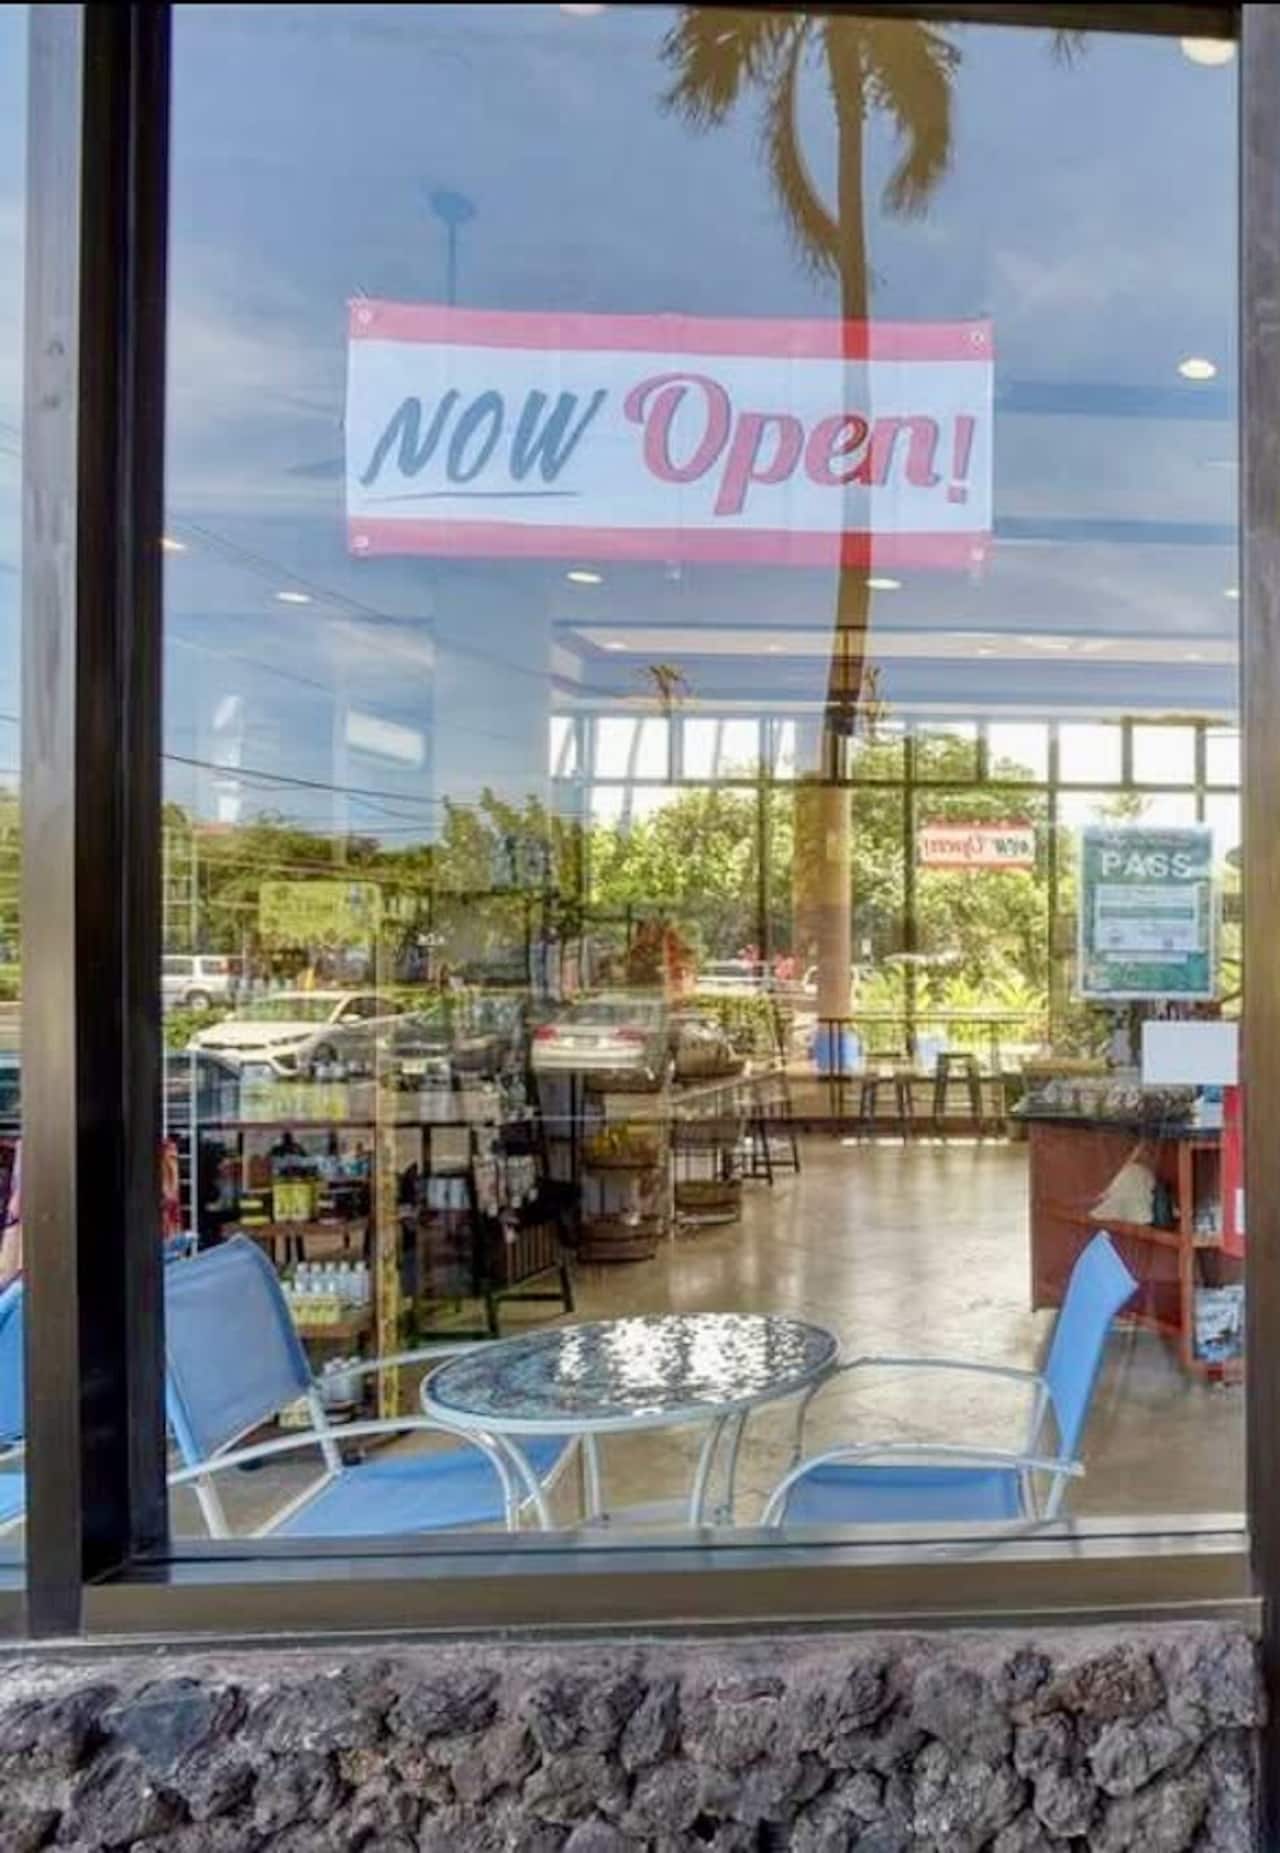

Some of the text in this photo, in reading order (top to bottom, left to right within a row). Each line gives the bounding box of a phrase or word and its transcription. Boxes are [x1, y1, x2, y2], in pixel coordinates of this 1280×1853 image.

[359, 372, 976, 516] NOW Open!
[1101, 852, 1193, 878] PASS
